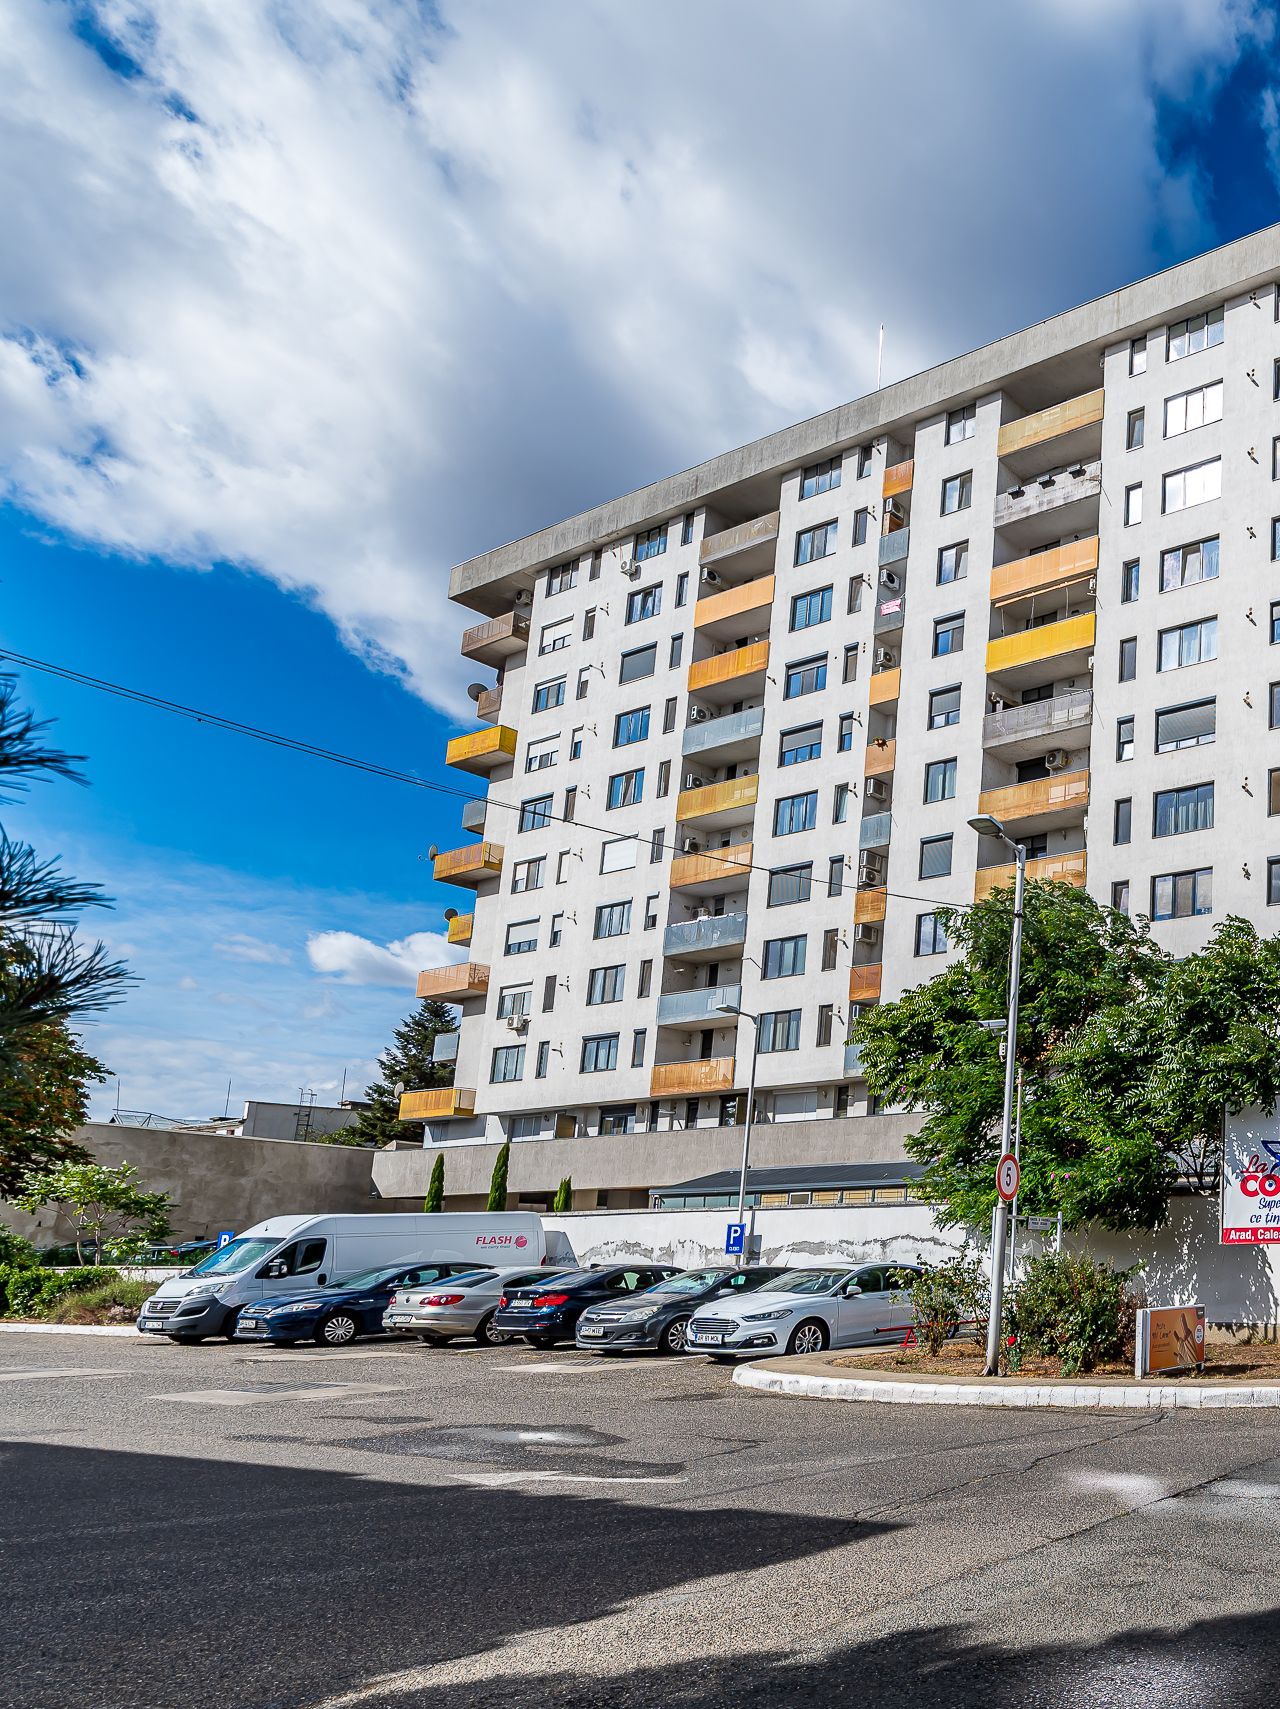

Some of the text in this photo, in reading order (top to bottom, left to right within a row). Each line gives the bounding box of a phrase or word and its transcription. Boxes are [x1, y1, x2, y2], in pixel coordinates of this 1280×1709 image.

[1240, 1153, 1269, 1174] La
[1005, 1166, 1012, 1187] 5
[1249, 1214, 1262, 1224] ce
[475, 1235, 513, 1245] FLASH
[730, 1226, 741, 1245] P
[1229, 1229, 1255, 1241] Arad,
